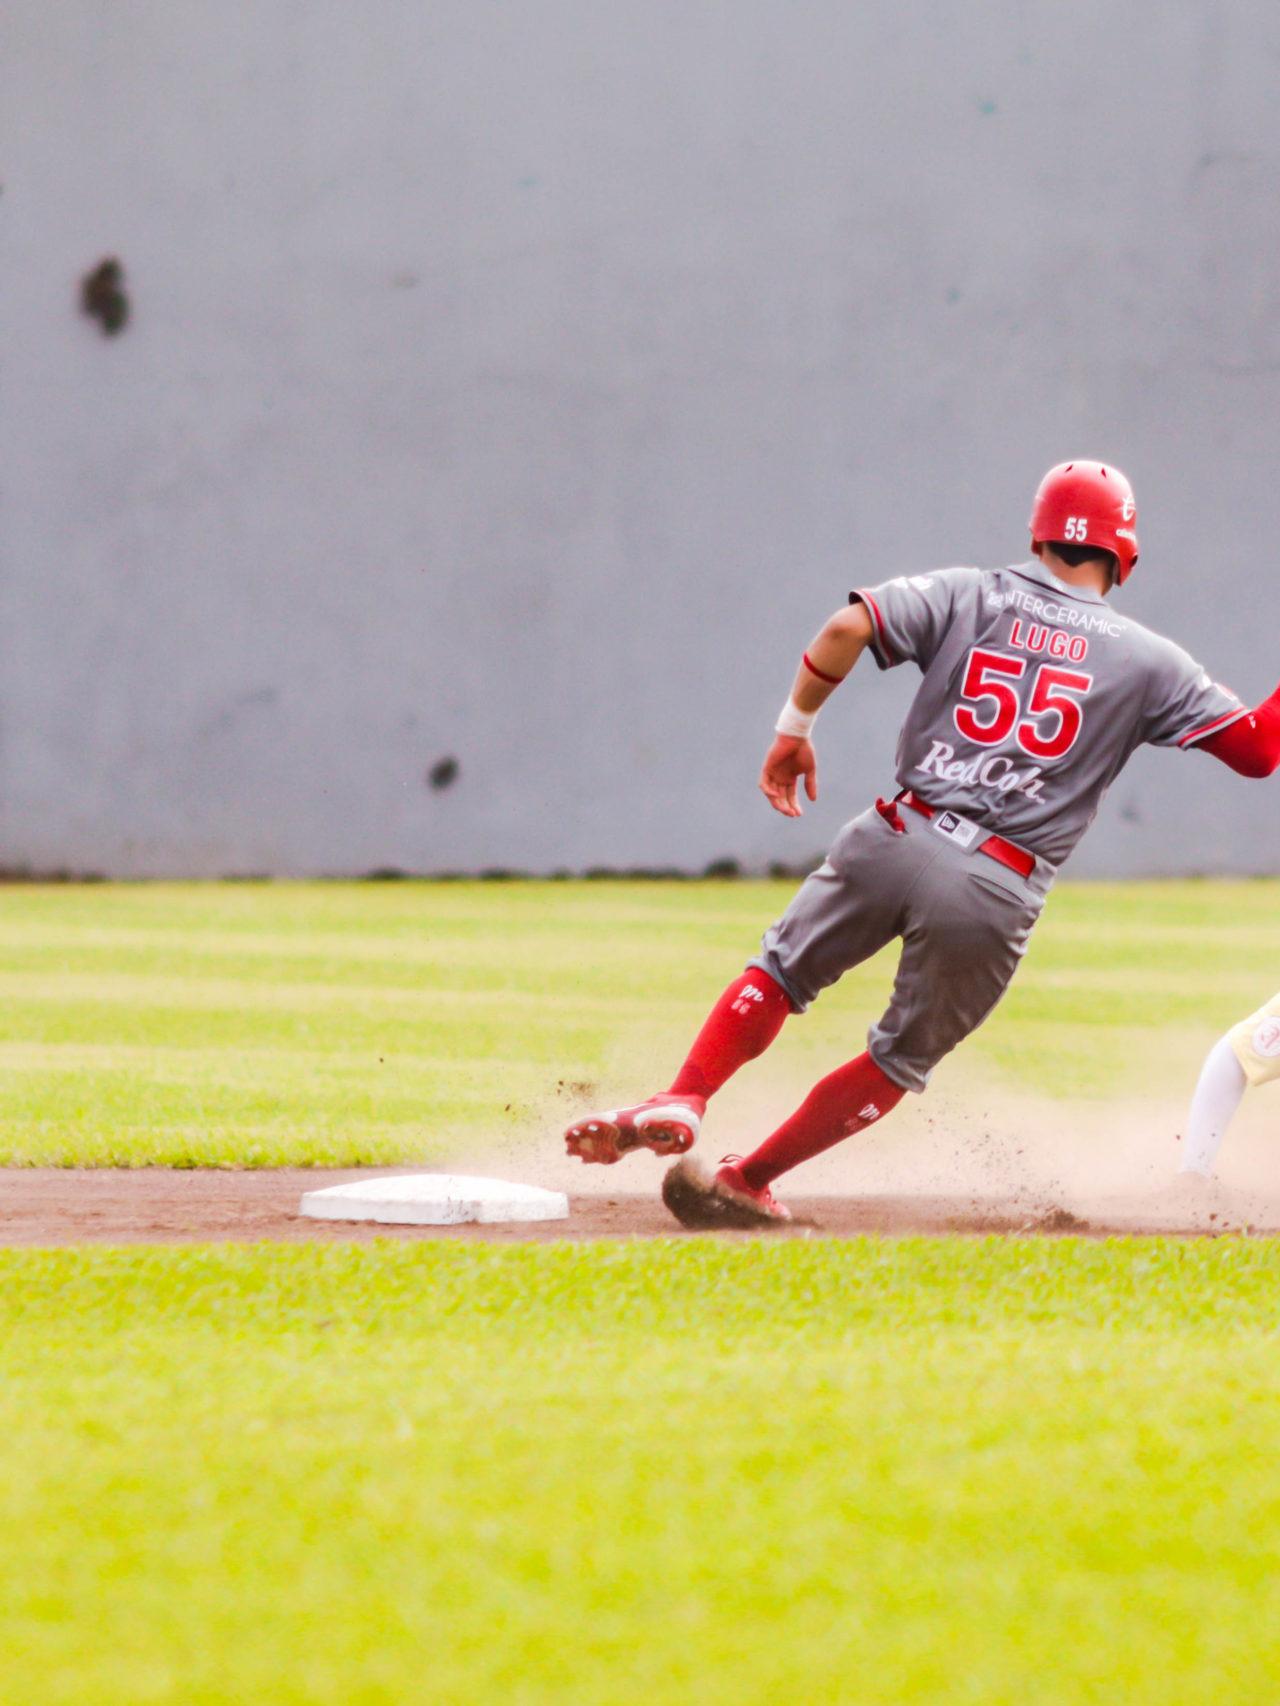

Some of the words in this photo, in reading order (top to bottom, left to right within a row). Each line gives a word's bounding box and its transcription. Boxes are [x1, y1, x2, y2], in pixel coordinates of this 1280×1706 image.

[1064, 516, 1088, 543] 55
[1008, 616, 1088, 664] LUGO
[953, 646, 1094, 761] 55
